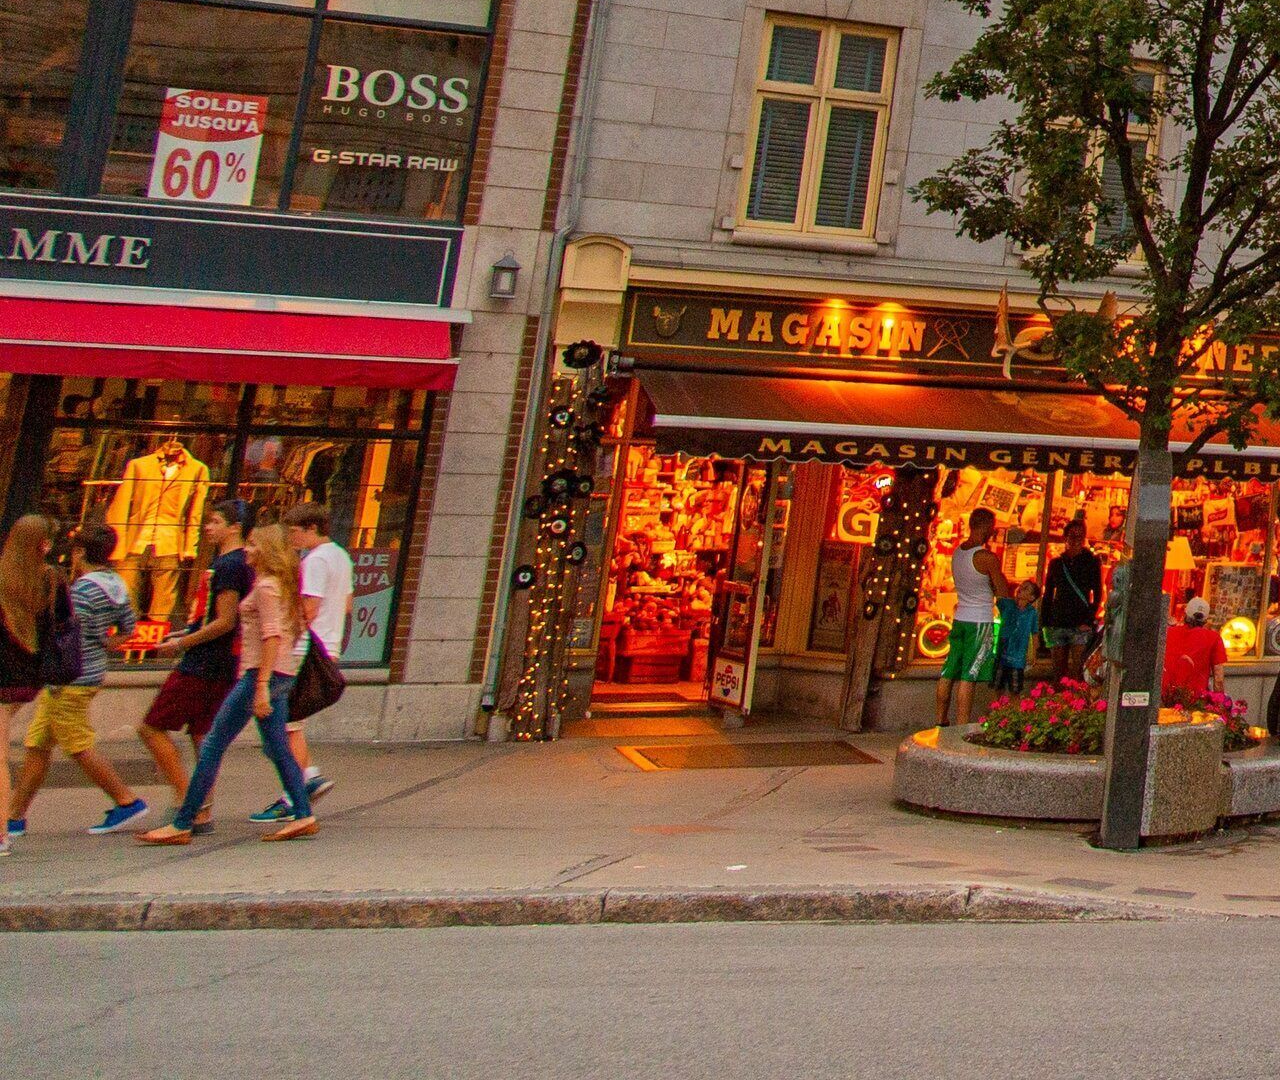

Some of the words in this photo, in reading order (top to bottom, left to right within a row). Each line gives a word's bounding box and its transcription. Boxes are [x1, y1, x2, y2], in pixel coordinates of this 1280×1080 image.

[321, 64, 470, 114] BOSS
[174, 95, 260, 115] SOLDE
[322, 105, 386, 119] HUGO
[406, 113, 464, 126] BOSS
[171, 114, 260, 133] JUSQU'À
[312, 149, 401, 168] G-STAR
[407, 156, 459, 171] RAW
[0, 228, 152, 268] MME
[706, 307, 927, 353] MAGASIN
[757, 437, 967, 461] MAGASIN
[715, 672, 740, 690] PEPSI
